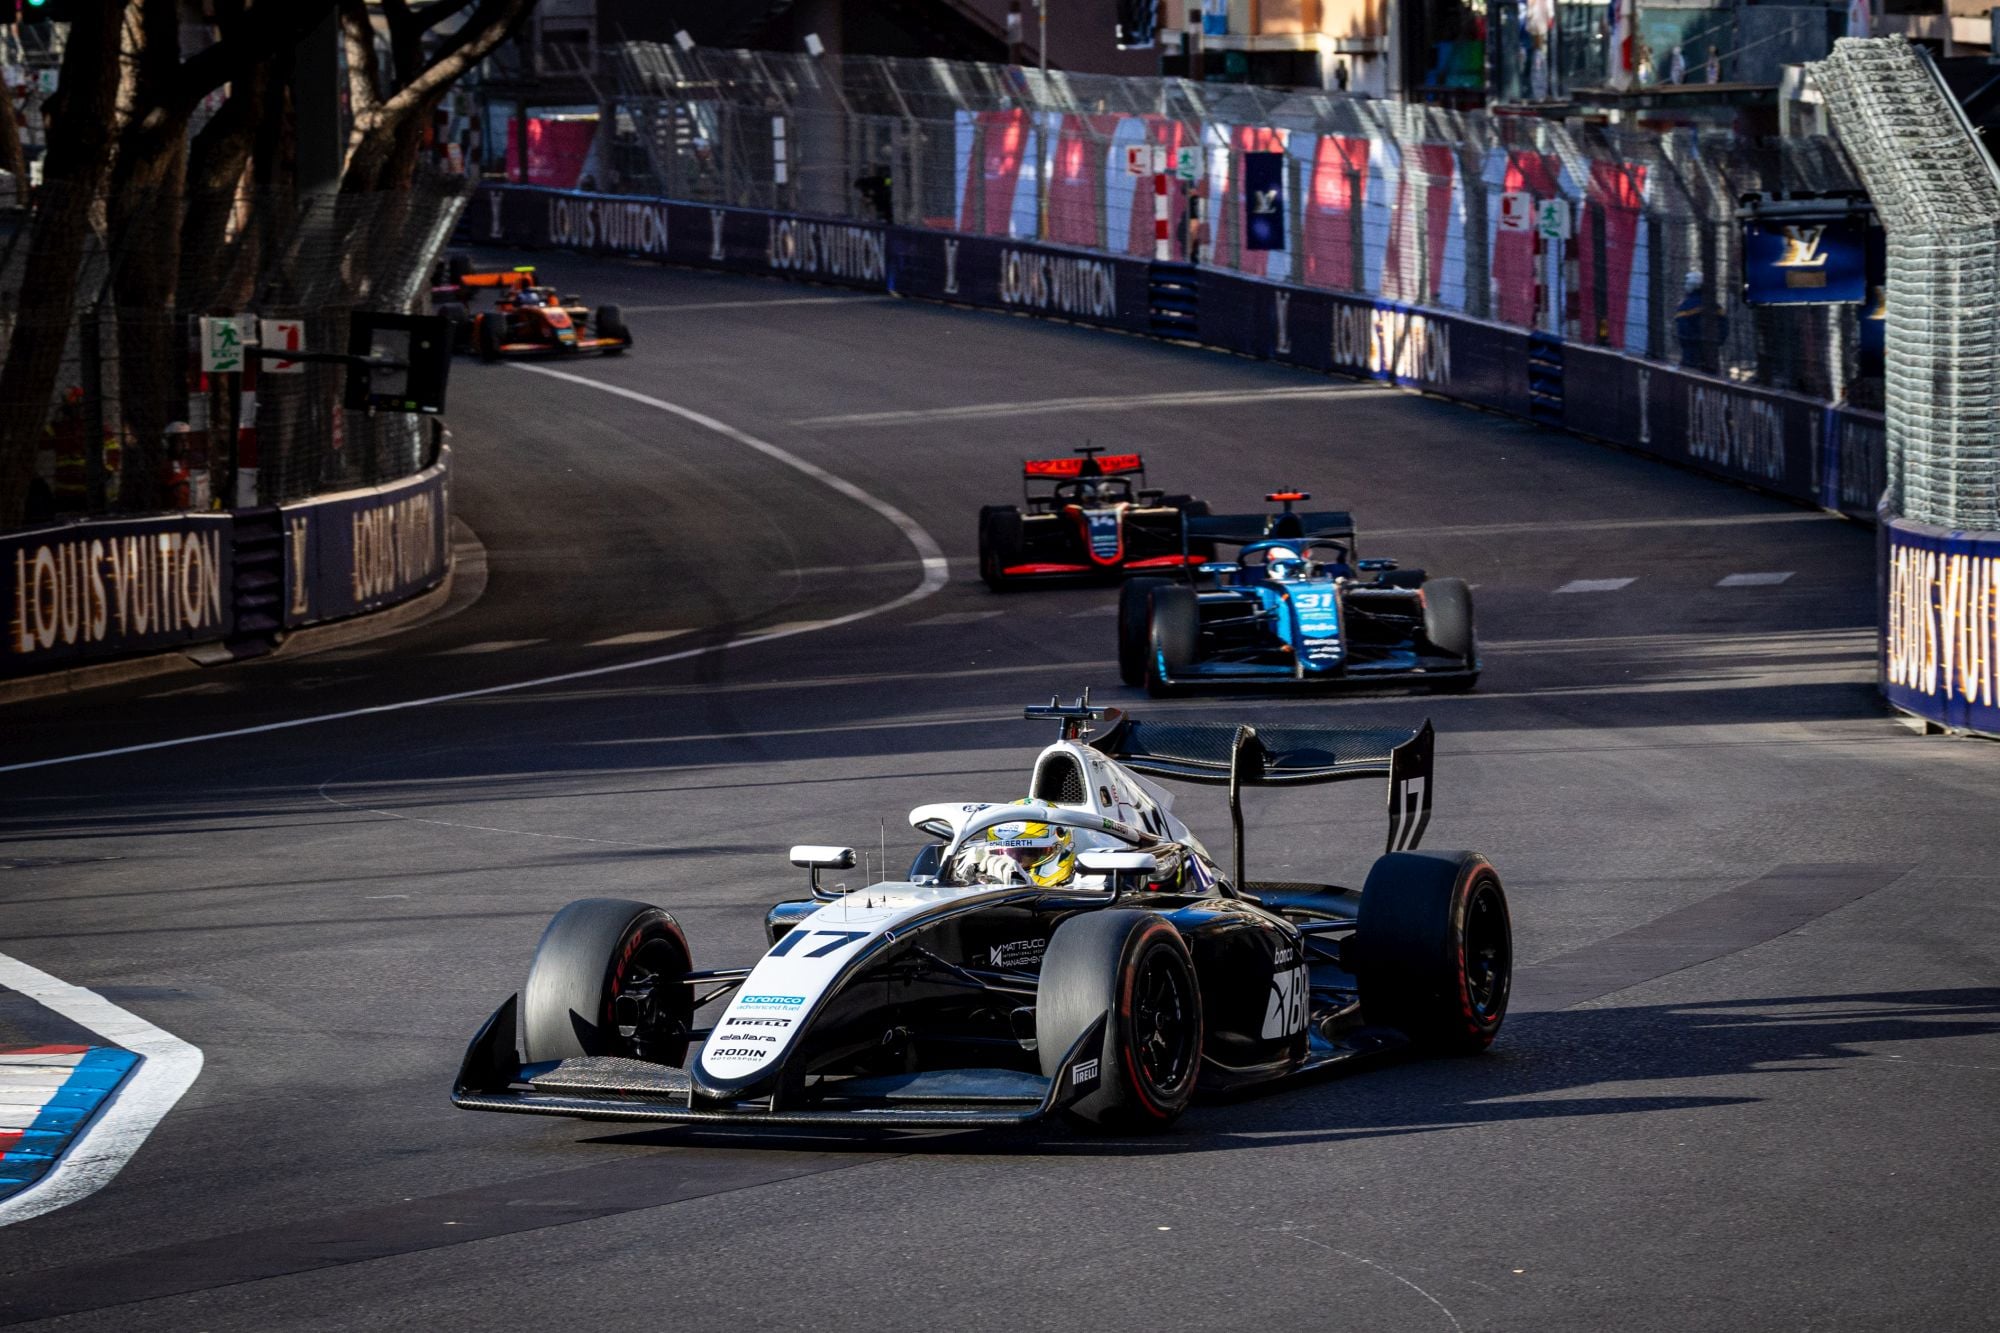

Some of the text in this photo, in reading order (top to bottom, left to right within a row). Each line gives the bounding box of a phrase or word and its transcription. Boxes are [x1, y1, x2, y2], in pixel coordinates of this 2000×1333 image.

[550, 199, 669, 254] LOUIS VUITTON
[769, 218, 886, 282] LOUIS VUITTON
[1001, 249, 1116, 318] LOUIS VUITTON
[1333, 302, 1381, 373] LOUIS
[353, 510, 394, 602] LOUIS
[14, 529, 222, 652] LOUIS VUITTON
[1295, 593, 1333, 608] 31
[1888, 544, 1937, 696] LOUIS
[1391, 776, 1425, 853] 17
[768, 930, 872, 957] 17
[1274, 947, 1293, 964] banco
[744, 996, 802, 1004] aramco
[720, 1034, 777, 1042] dallara
[726, 1017, 792, 1027] PIRELLI
[713, 1048, 767, 1058] RODIN
[1072, 1058, 1099, 1085] PIRELLI
